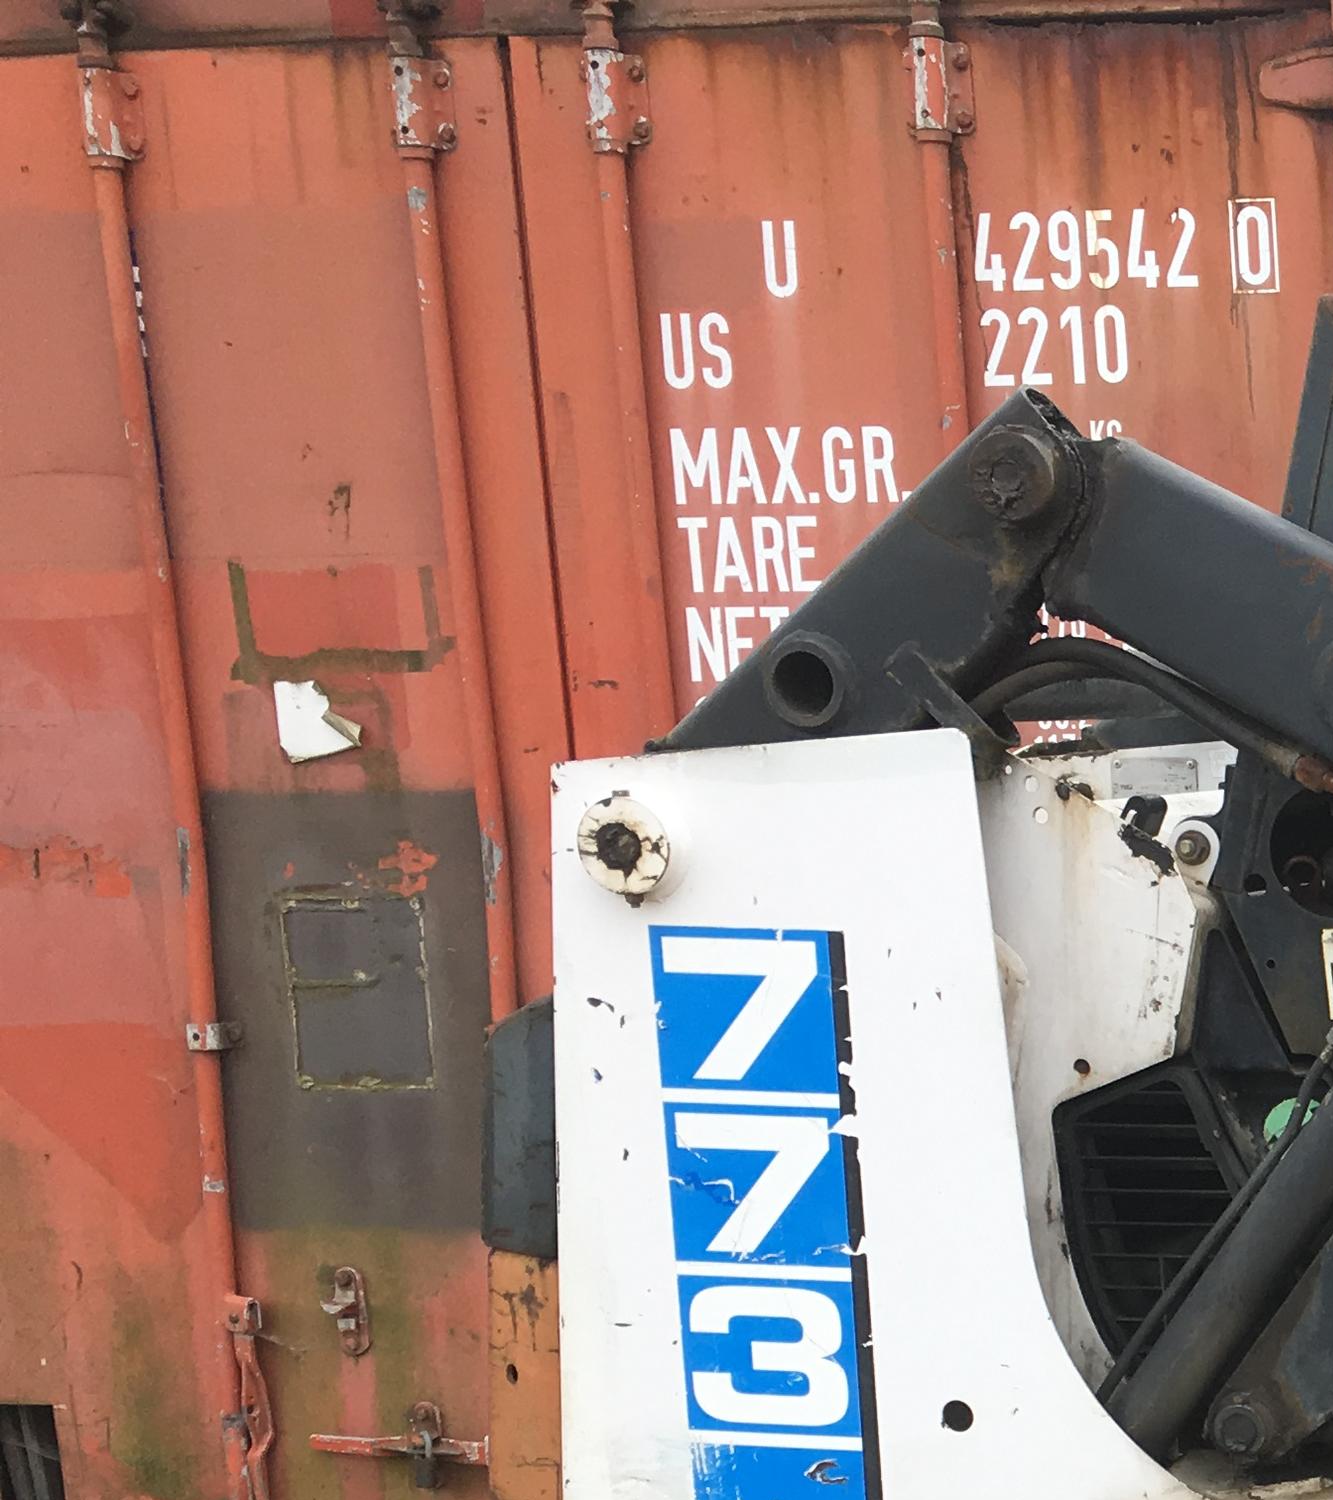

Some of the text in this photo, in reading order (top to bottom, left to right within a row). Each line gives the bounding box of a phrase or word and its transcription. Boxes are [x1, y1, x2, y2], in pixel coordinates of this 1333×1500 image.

[761, 220, 799, 297] U
[975, 206, 1270, 292] 429542 0
[659, 313, 733, 390] US
[980, 305, 1129, 386] 2210
[676, 516, 823, 593] TARE
[660, 936, 850, 1427] 773
